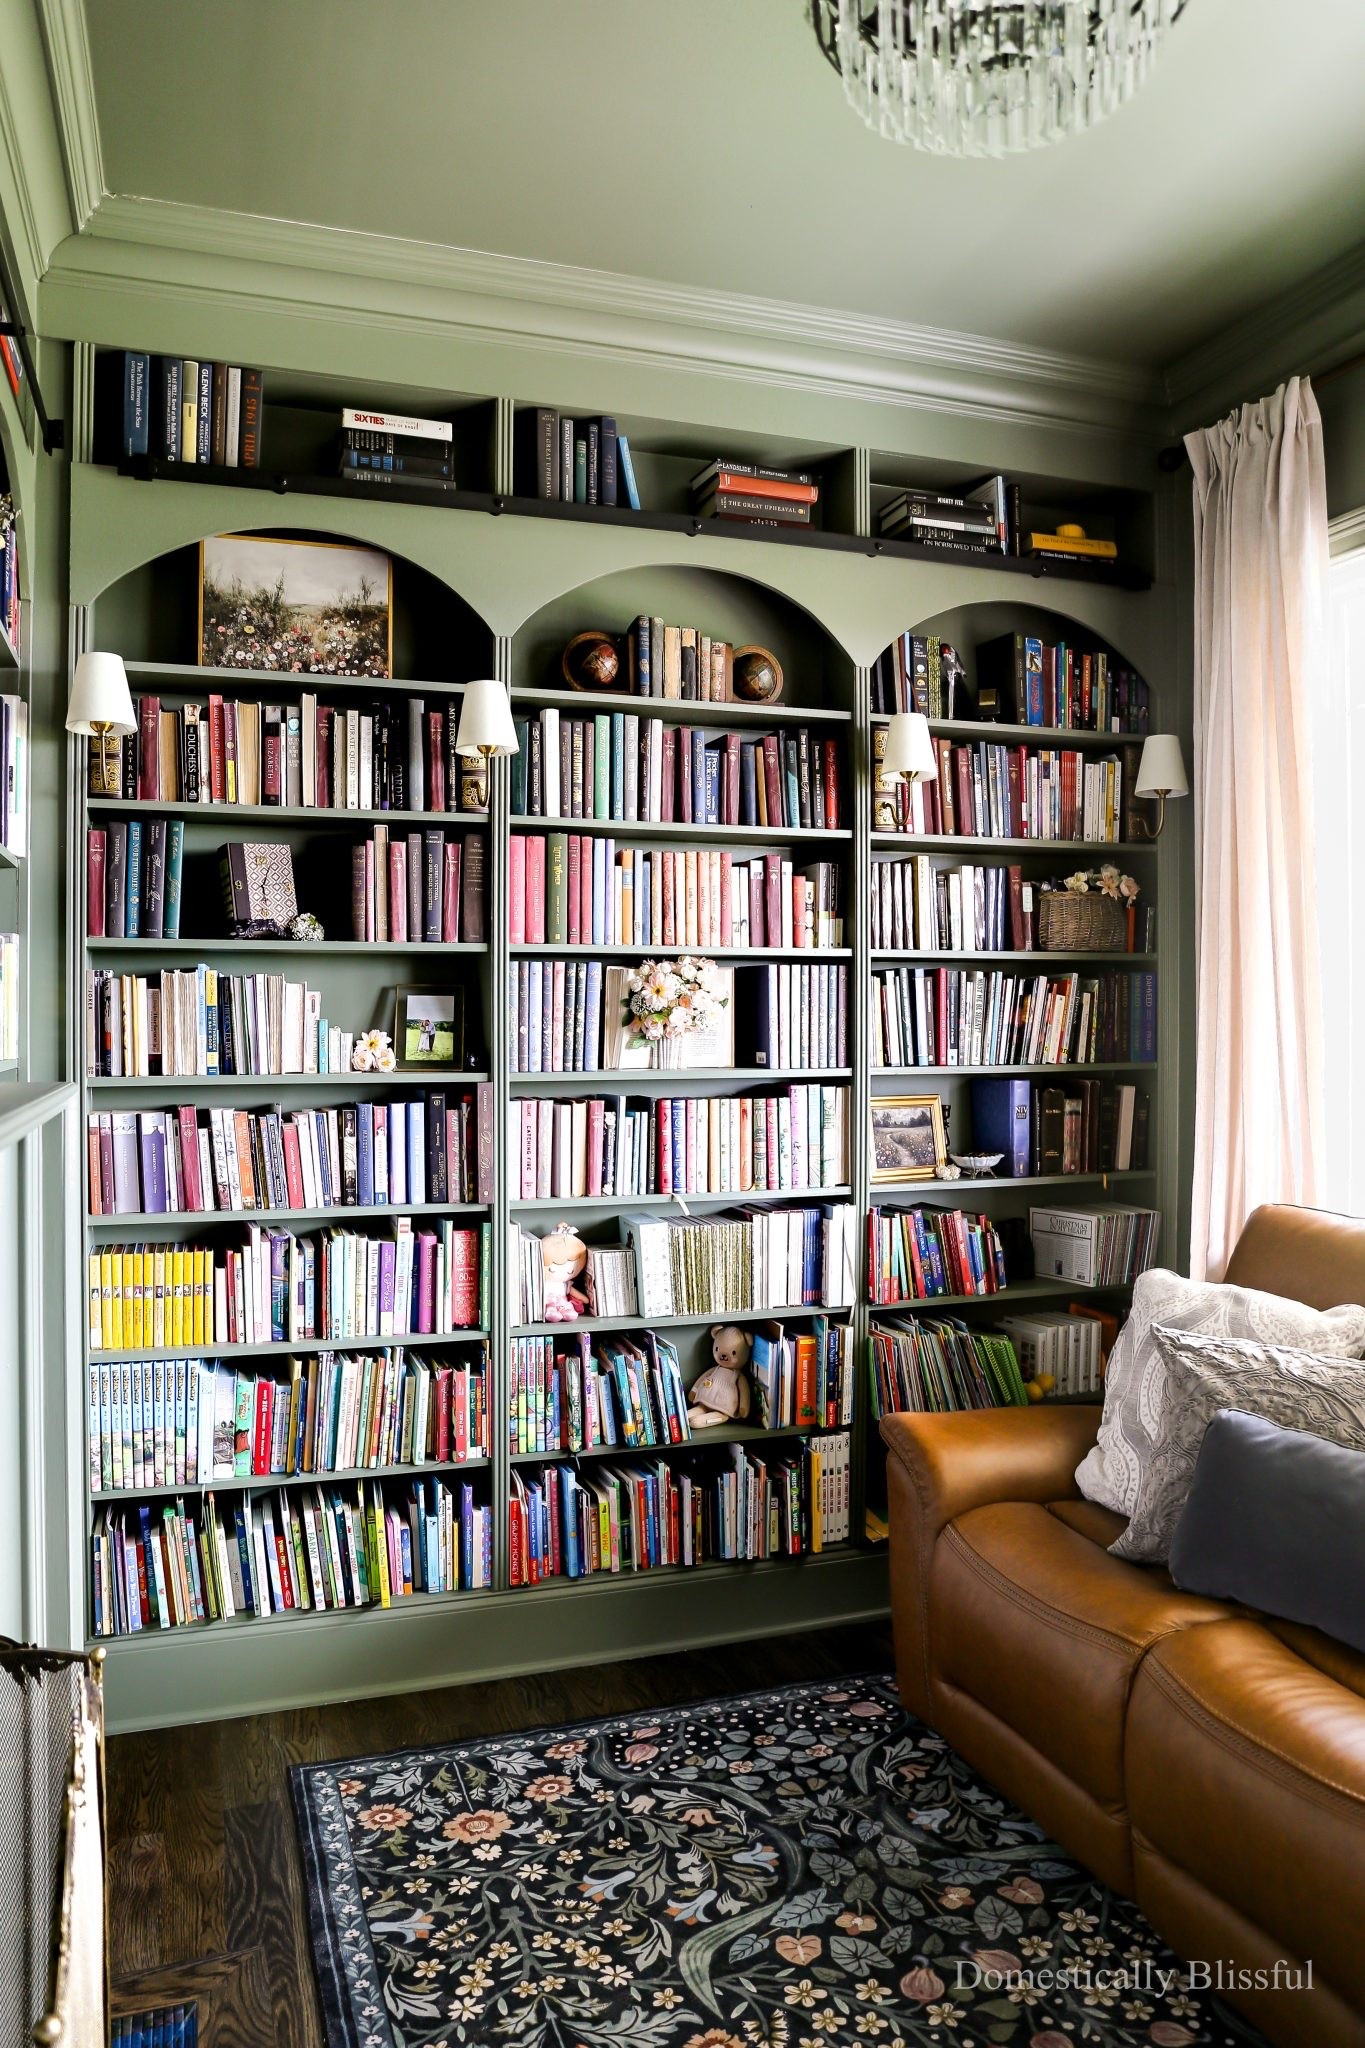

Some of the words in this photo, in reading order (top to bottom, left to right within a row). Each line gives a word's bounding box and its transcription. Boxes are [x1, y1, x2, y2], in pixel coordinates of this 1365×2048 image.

[200, 396, 208, 418] BECK
[246, 399, 257, 425] 1945
[354, 413, 385, 426] SIXTIES
[722, 462, 752, 473] LANDSLIDE
[764, 504, 796, 513] UPHEAVAL
[935, 540, 969, 550] BORROWED
[448, 707, 456, 720] MY
[573, 733, 582, 752] JANET
[188, 734, 196, 772] DUCHESS
[573, 752, 582, 784] EVANOVICH
[553, 846, 562, 862] LITTLE
[131, 843, 140, 892] NORTHWOMEN
[554, 863, 563, 886] WOMEN
[976, 994, 983, 1003] WE
[976, 1004, 982, 1012] BE
[1016, 1106, 1029, 1114] NIV
[480, 1158, 491, 1180] Bride
[438, 1180, 444, 1189] IN
[1050, 1216, 1088, 1230] CHRISTMAS
[930, 1252, 938, 1278] Christmas
[308, 1532, 318, 1560] FARM?
[128, 1564, 136, 1582] Little
